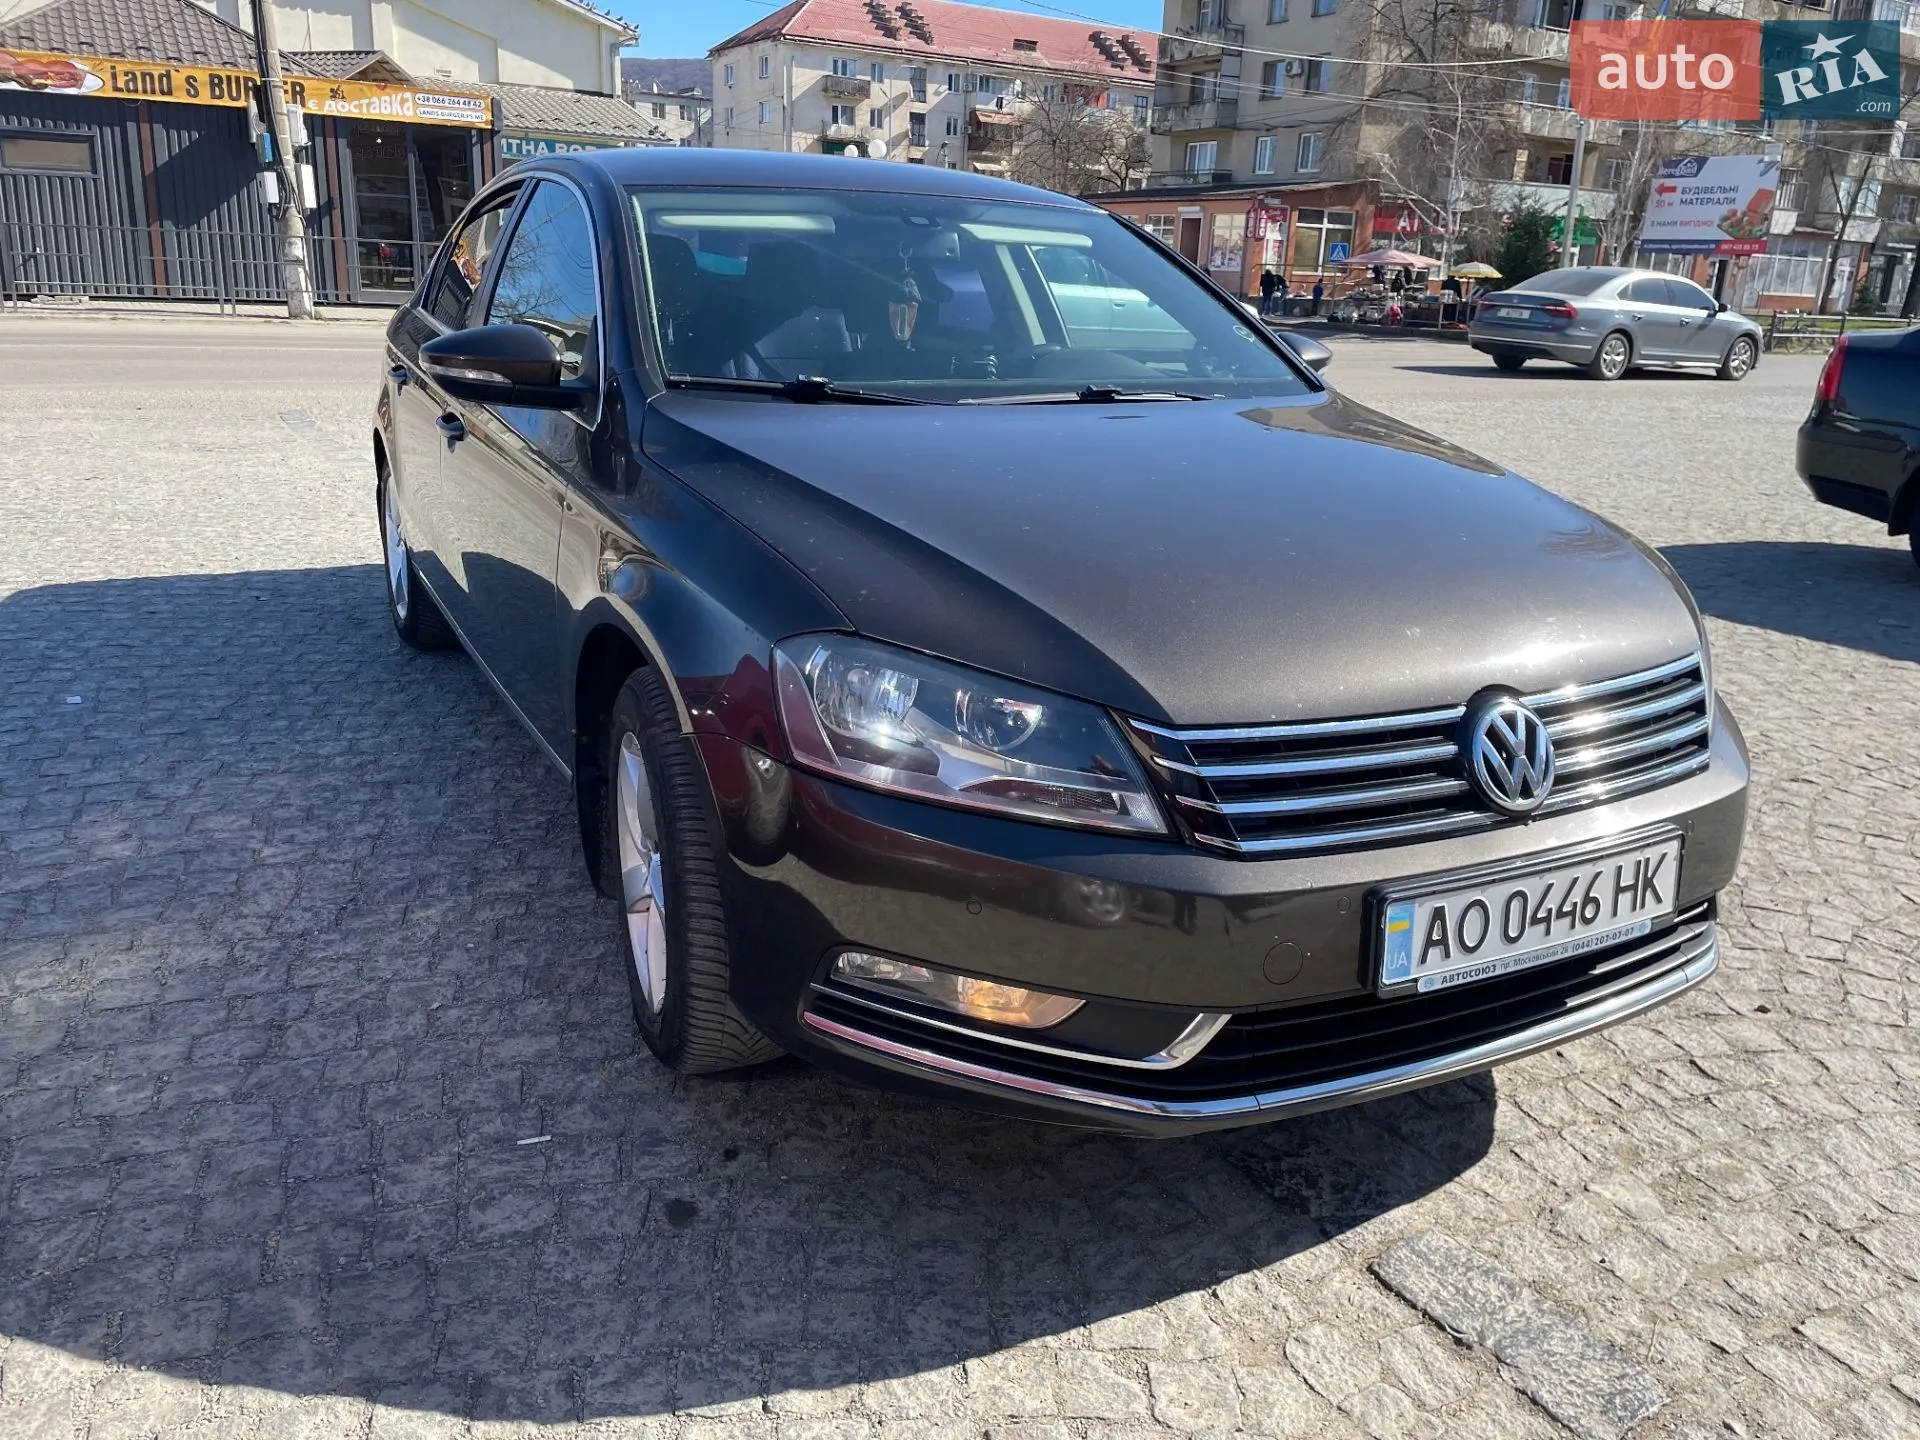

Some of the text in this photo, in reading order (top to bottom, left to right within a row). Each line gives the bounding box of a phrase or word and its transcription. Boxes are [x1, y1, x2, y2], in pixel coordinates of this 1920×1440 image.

[1681, 185, 1739, 195] БУДІВЕЛЬНІ
[1680, 197, 1736, 206] МАТЕРІАЛИ
[1420, 852, 1668, 965] AO 0446 HK
[1387, 950, 1408, 969] UA
[1441, 963, 1496, 985] АВТОСОЮЗ
[1571, 938, 1594, 953] (044)
[1595, 927, 1634, 946] 207-07-07
